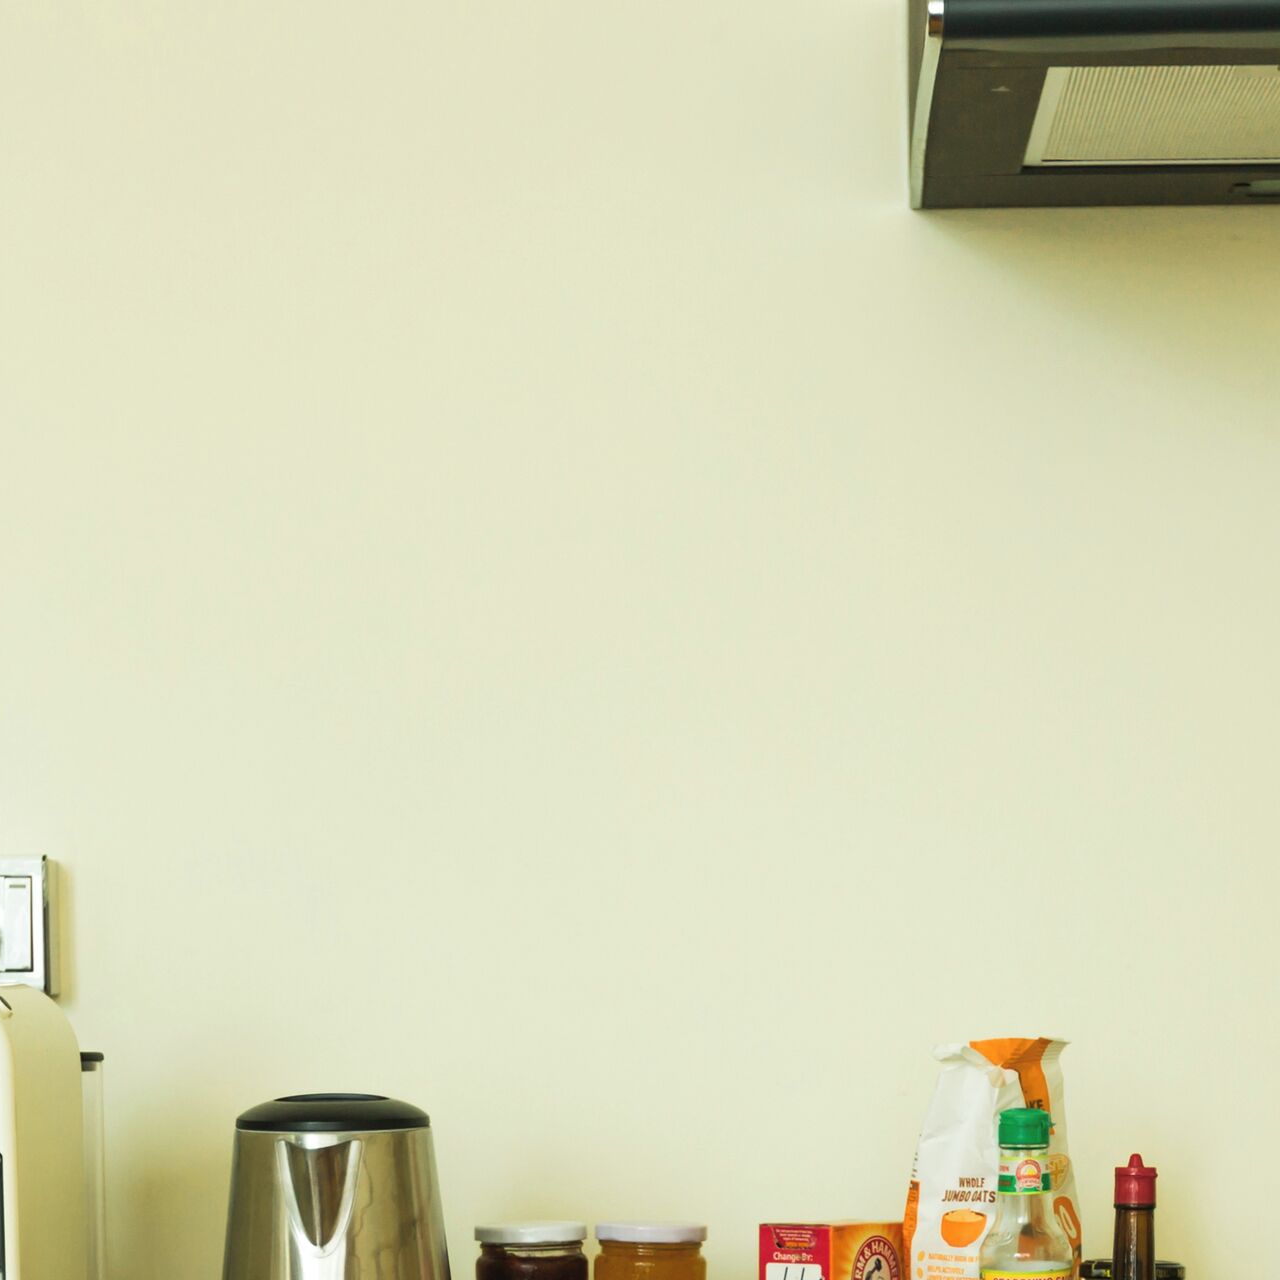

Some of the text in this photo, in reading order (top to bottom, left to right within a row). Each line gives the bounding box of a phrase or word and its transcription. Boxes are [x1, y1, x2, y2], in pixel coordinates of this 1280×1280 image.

[958, 1176, 985, 1188] WHOLE
[941, 1189, 997, 1204] JUMBO OATS
[772, 1251, 800, 1263] Change
[863, 1246, 872, 1258] &
